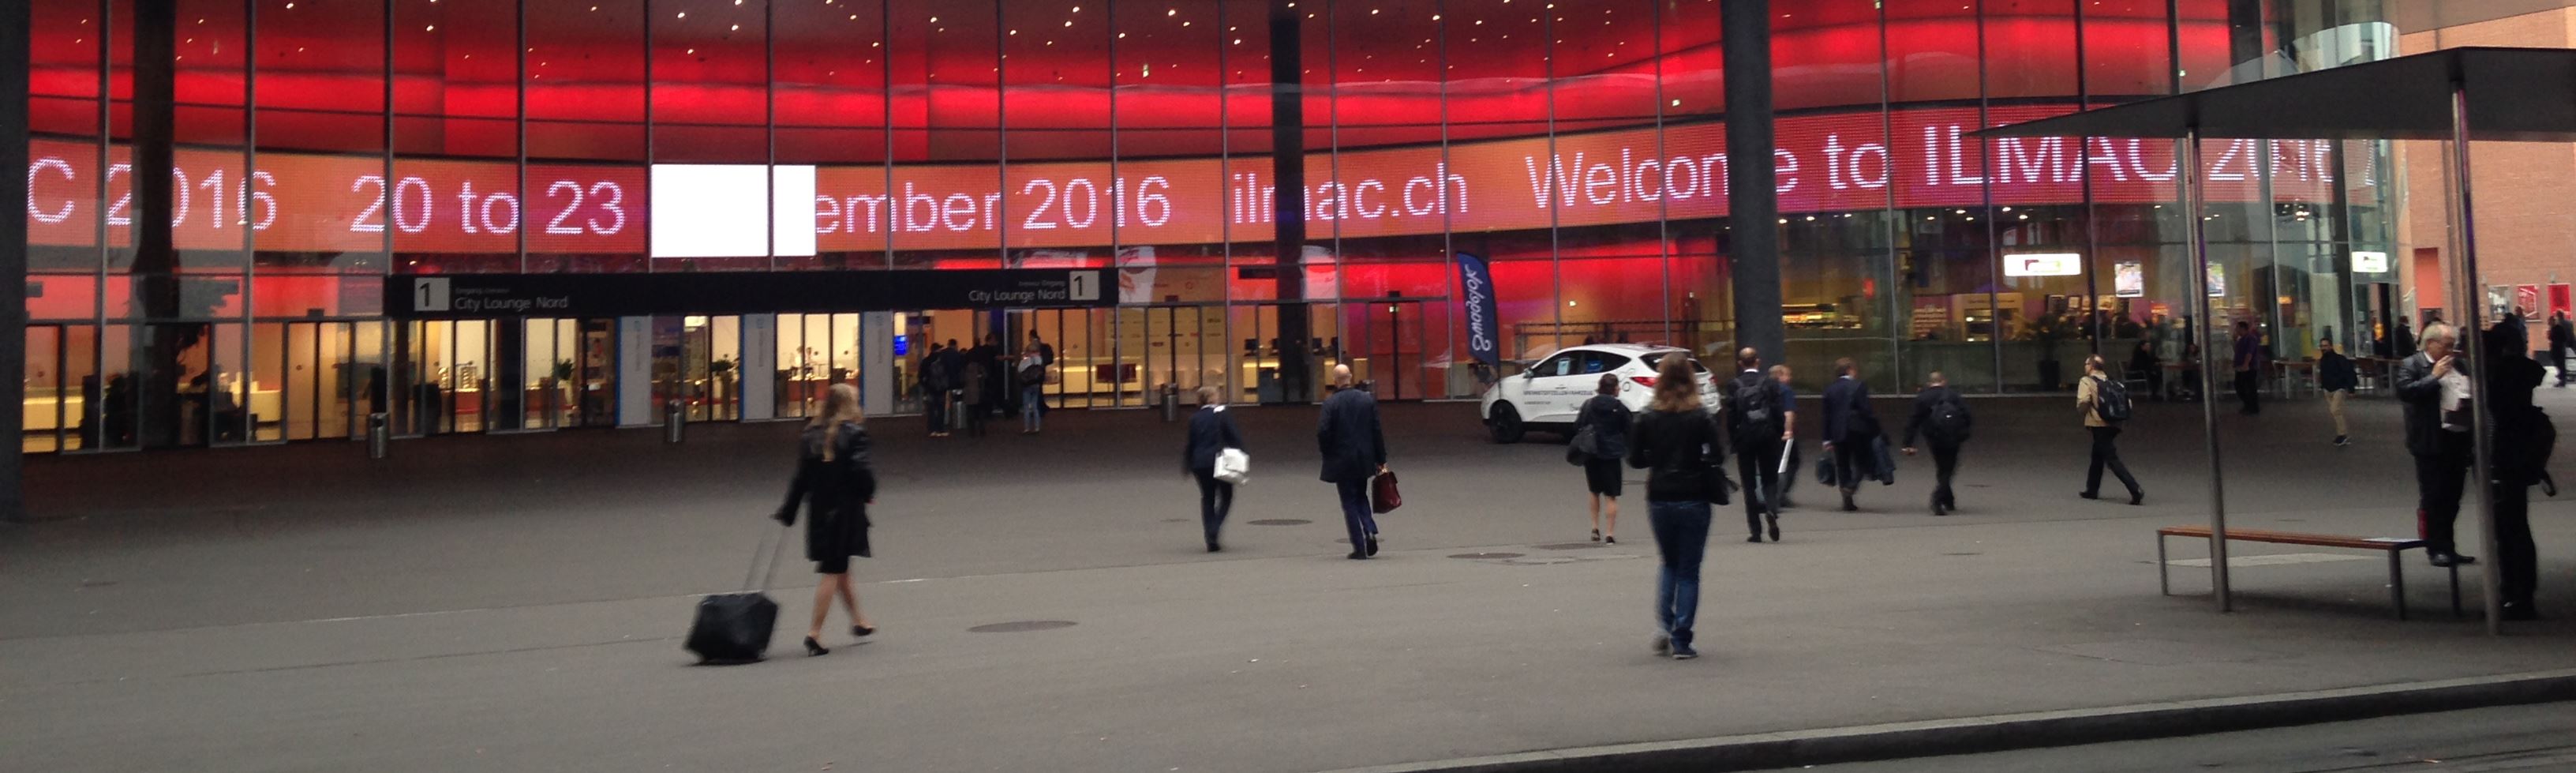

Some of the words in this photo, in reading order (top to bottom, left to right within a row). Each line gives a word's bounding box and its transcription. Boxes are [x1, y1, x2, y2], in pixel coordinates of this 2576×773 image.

[1822, 132, 1886, 189] to
[1923, 124, 2177, 186] ILMAC
[350, 175, 432, 233] 20
[458, 181, 519, 233] to
[545, 181, 625, 235] 23
[815, 182, 1001, 234] ember
[1024, 175, 1170, 229] 2016
[419, 282, 430, 307] 1
[968, 289, 991, 304] City
[994, 289, 1035, 304] Lounge
[1038, 288, 1066, 300] Nord
[1073, 276, 1083, 297] 1
[455, 297, 480, 313] City
[484, 297, 531, 313] Lounge
[536, 295, 570, 309] Nord
